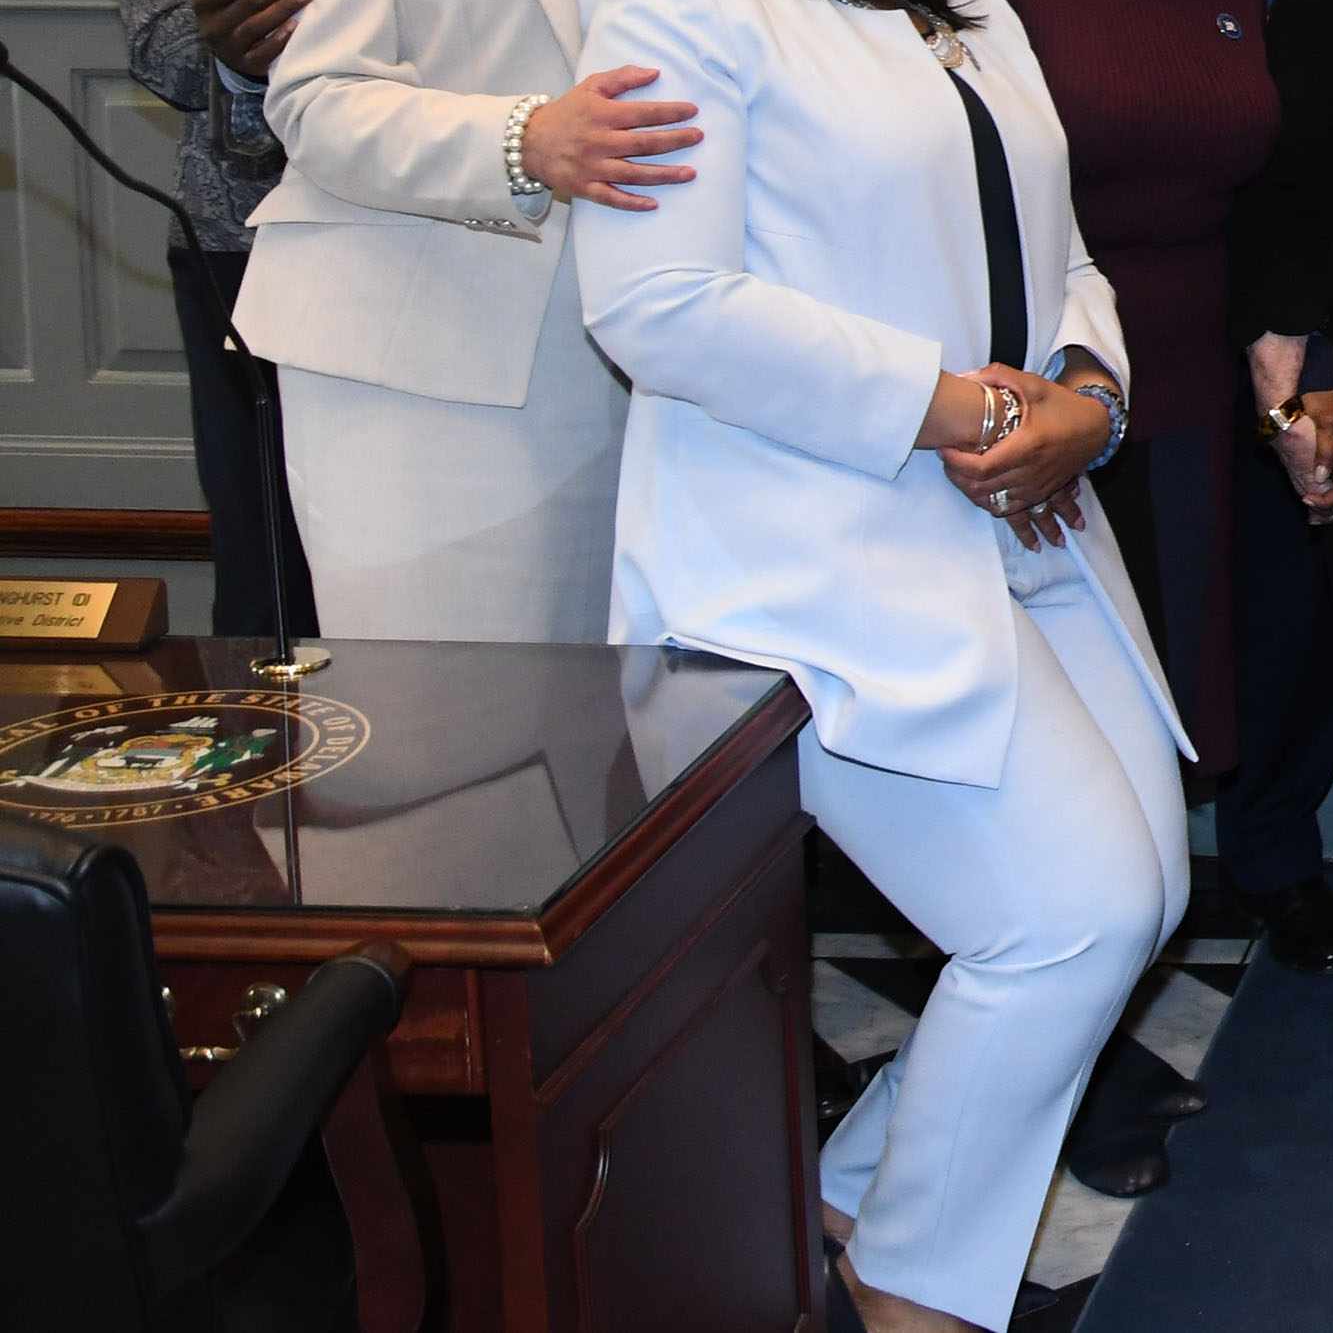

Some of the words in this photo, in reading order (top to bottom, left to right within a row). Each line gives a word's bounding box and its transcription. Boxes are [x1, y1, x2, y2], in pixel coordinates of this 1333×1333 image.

[32, 613, 85, 627] District
[74, 702, 127, 720] OF
[149, 692, 227, 709] THE
[322, 715, 357, 738] OF
[103, 803, 162, 822] 1787
